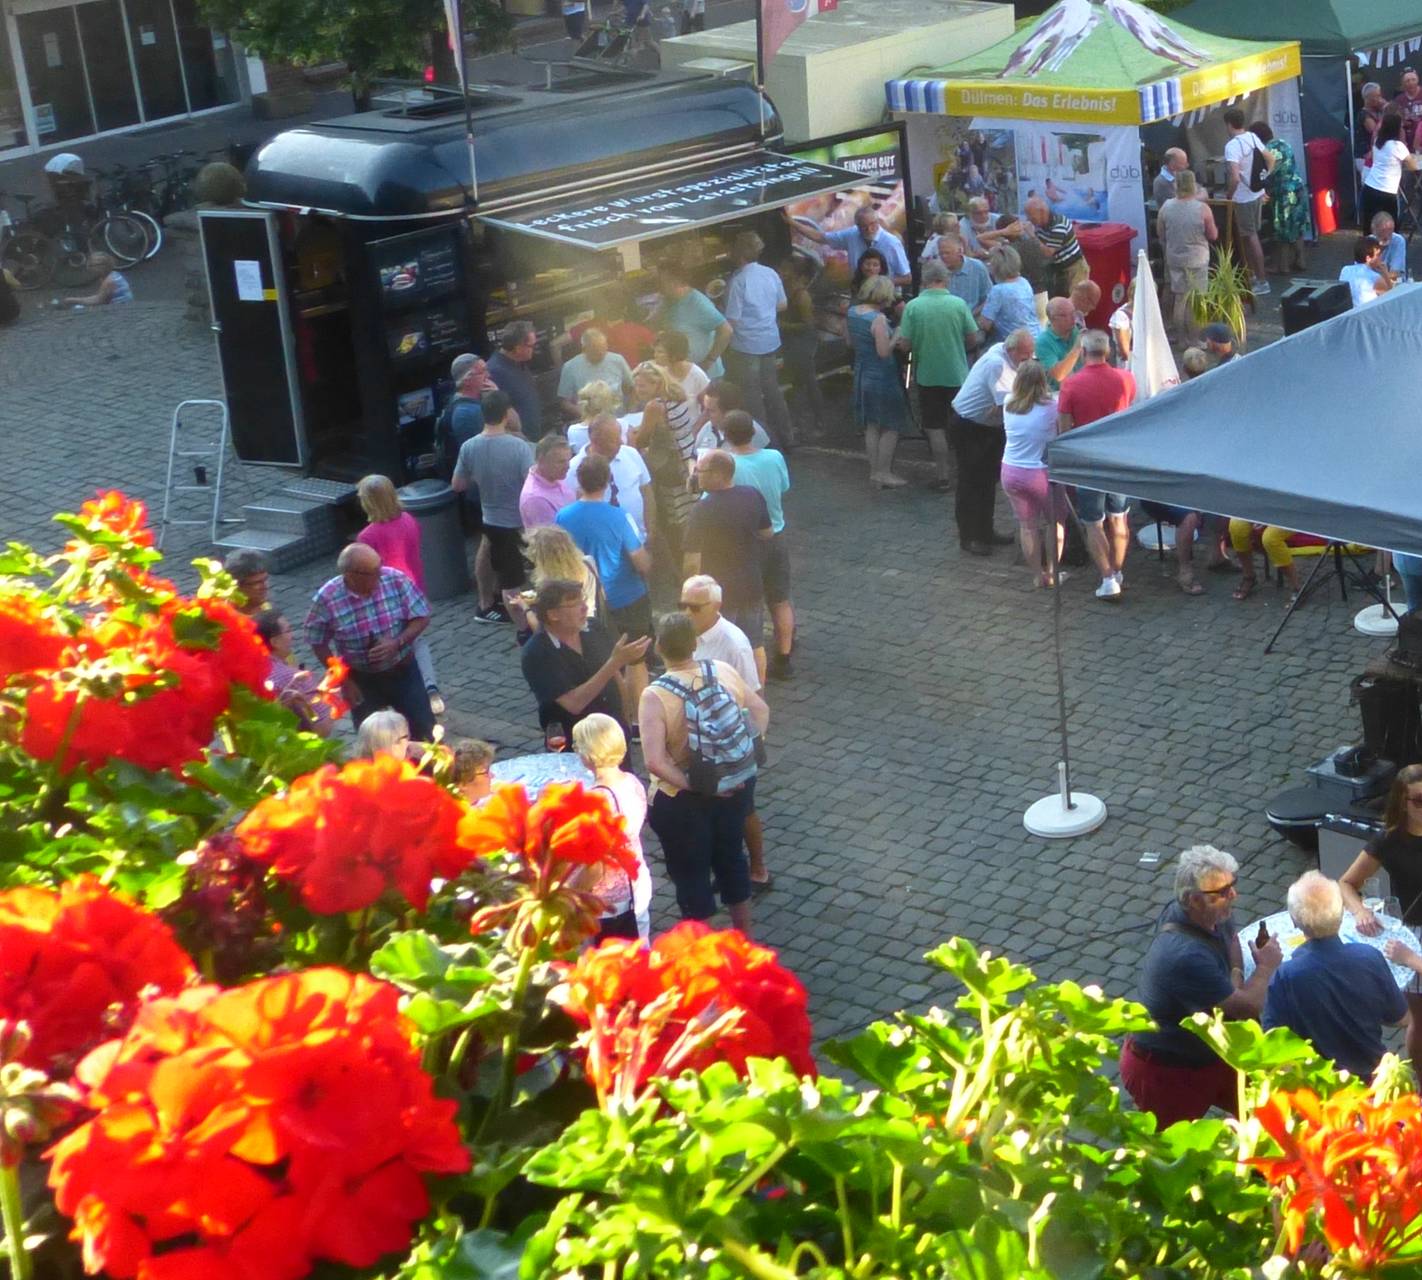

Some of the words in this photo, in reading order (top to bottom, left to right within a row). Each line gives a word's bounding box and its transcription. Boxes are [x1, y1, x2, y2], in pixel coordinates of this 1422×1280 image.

[960, 88, 1017, 105] Dülmen:
[1022, 91, 1048, 108] Das
[1052, 93, 1117, 112] Erlebnis!
[557, 212, 639, 233] frisch
[635, 201, 685, 215] vom
[681, 166, 823, 203] Lavasteingrill
[516, 206, 609, 230] Leckere
